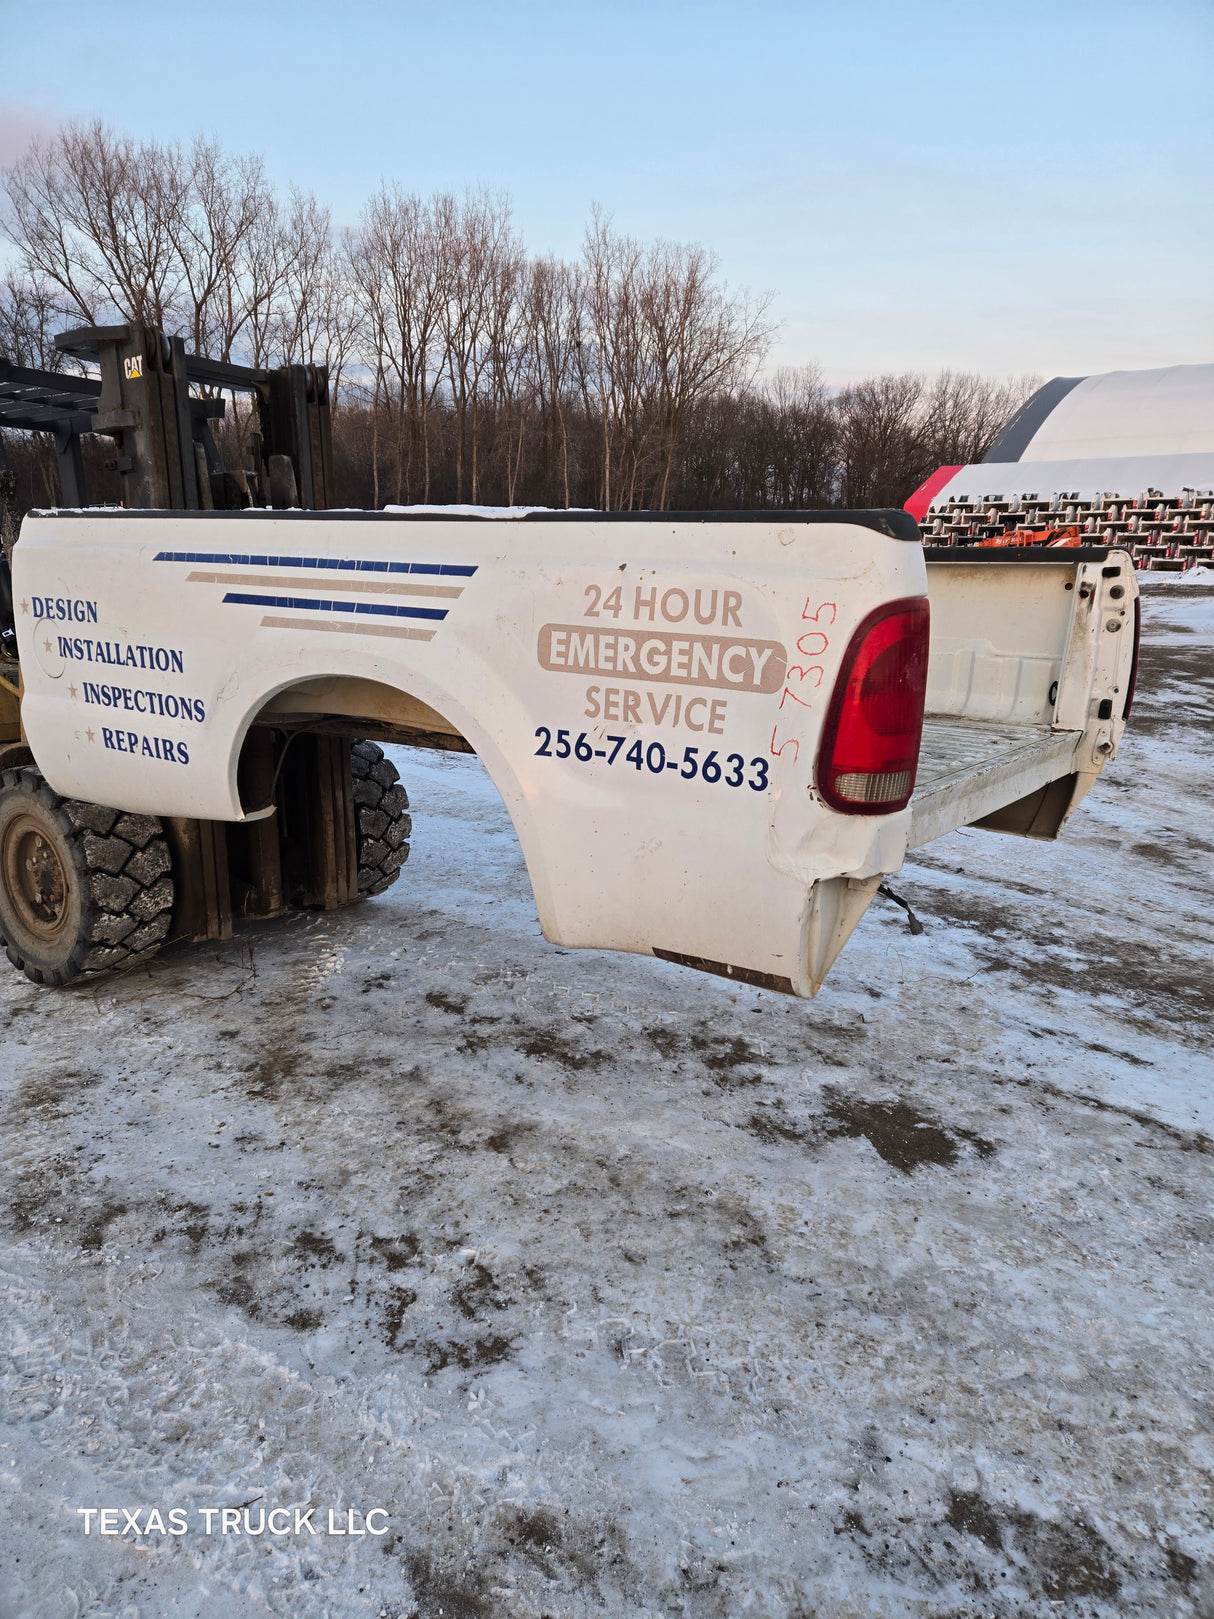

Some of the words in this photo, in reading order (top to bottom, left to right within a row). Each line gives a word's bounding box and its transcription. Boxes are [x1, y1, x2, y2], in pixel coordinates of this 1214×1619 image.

[124, 355, 143, 379] CAT
[31, 597, 98, 623] DESIGN
[584, 584, 622, 618] 24
[633, 586, 743, 627] HOUR
[57, 636, 184, 673] INSTALLATION
[550, 630, 773, 686] EMERGENCY
[82, 682, 206, 723] INSPECTIONS
[584, 686, 728, 735] SERVICE
[101, 727, 190, 765] REPAIRS
[534, 727, 769, 792] 256-740-5633
